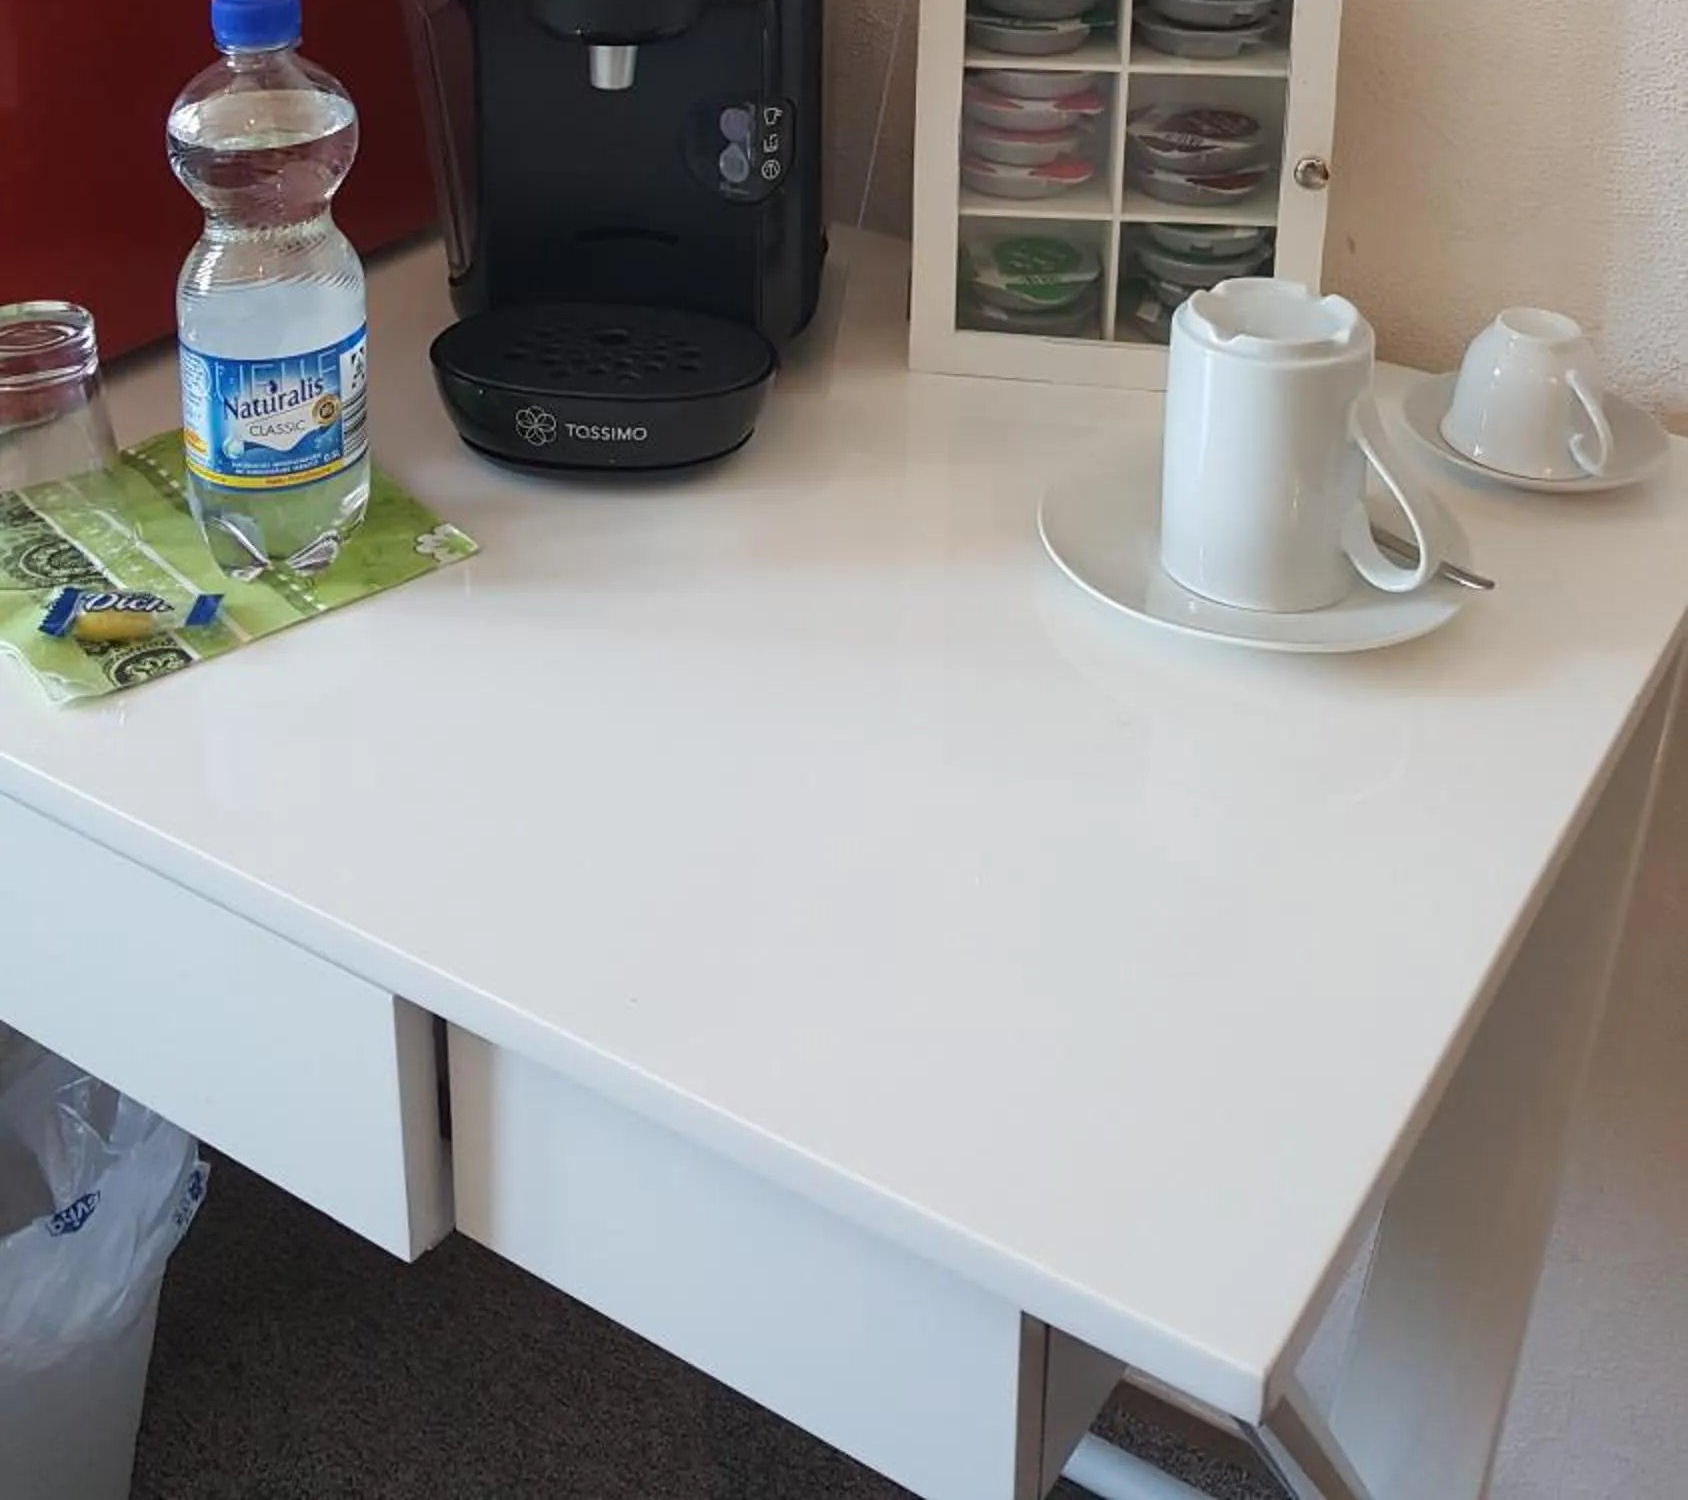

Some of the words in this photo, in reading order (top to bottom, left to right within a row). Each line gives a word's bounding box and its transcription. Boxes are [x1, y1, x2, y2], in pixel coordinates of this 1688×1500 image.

[223, 376, 326, 420] Naturalis
[249, 419, 306, 437] CLASSIC
[565, 423, 648, 441] TOSSIMO
